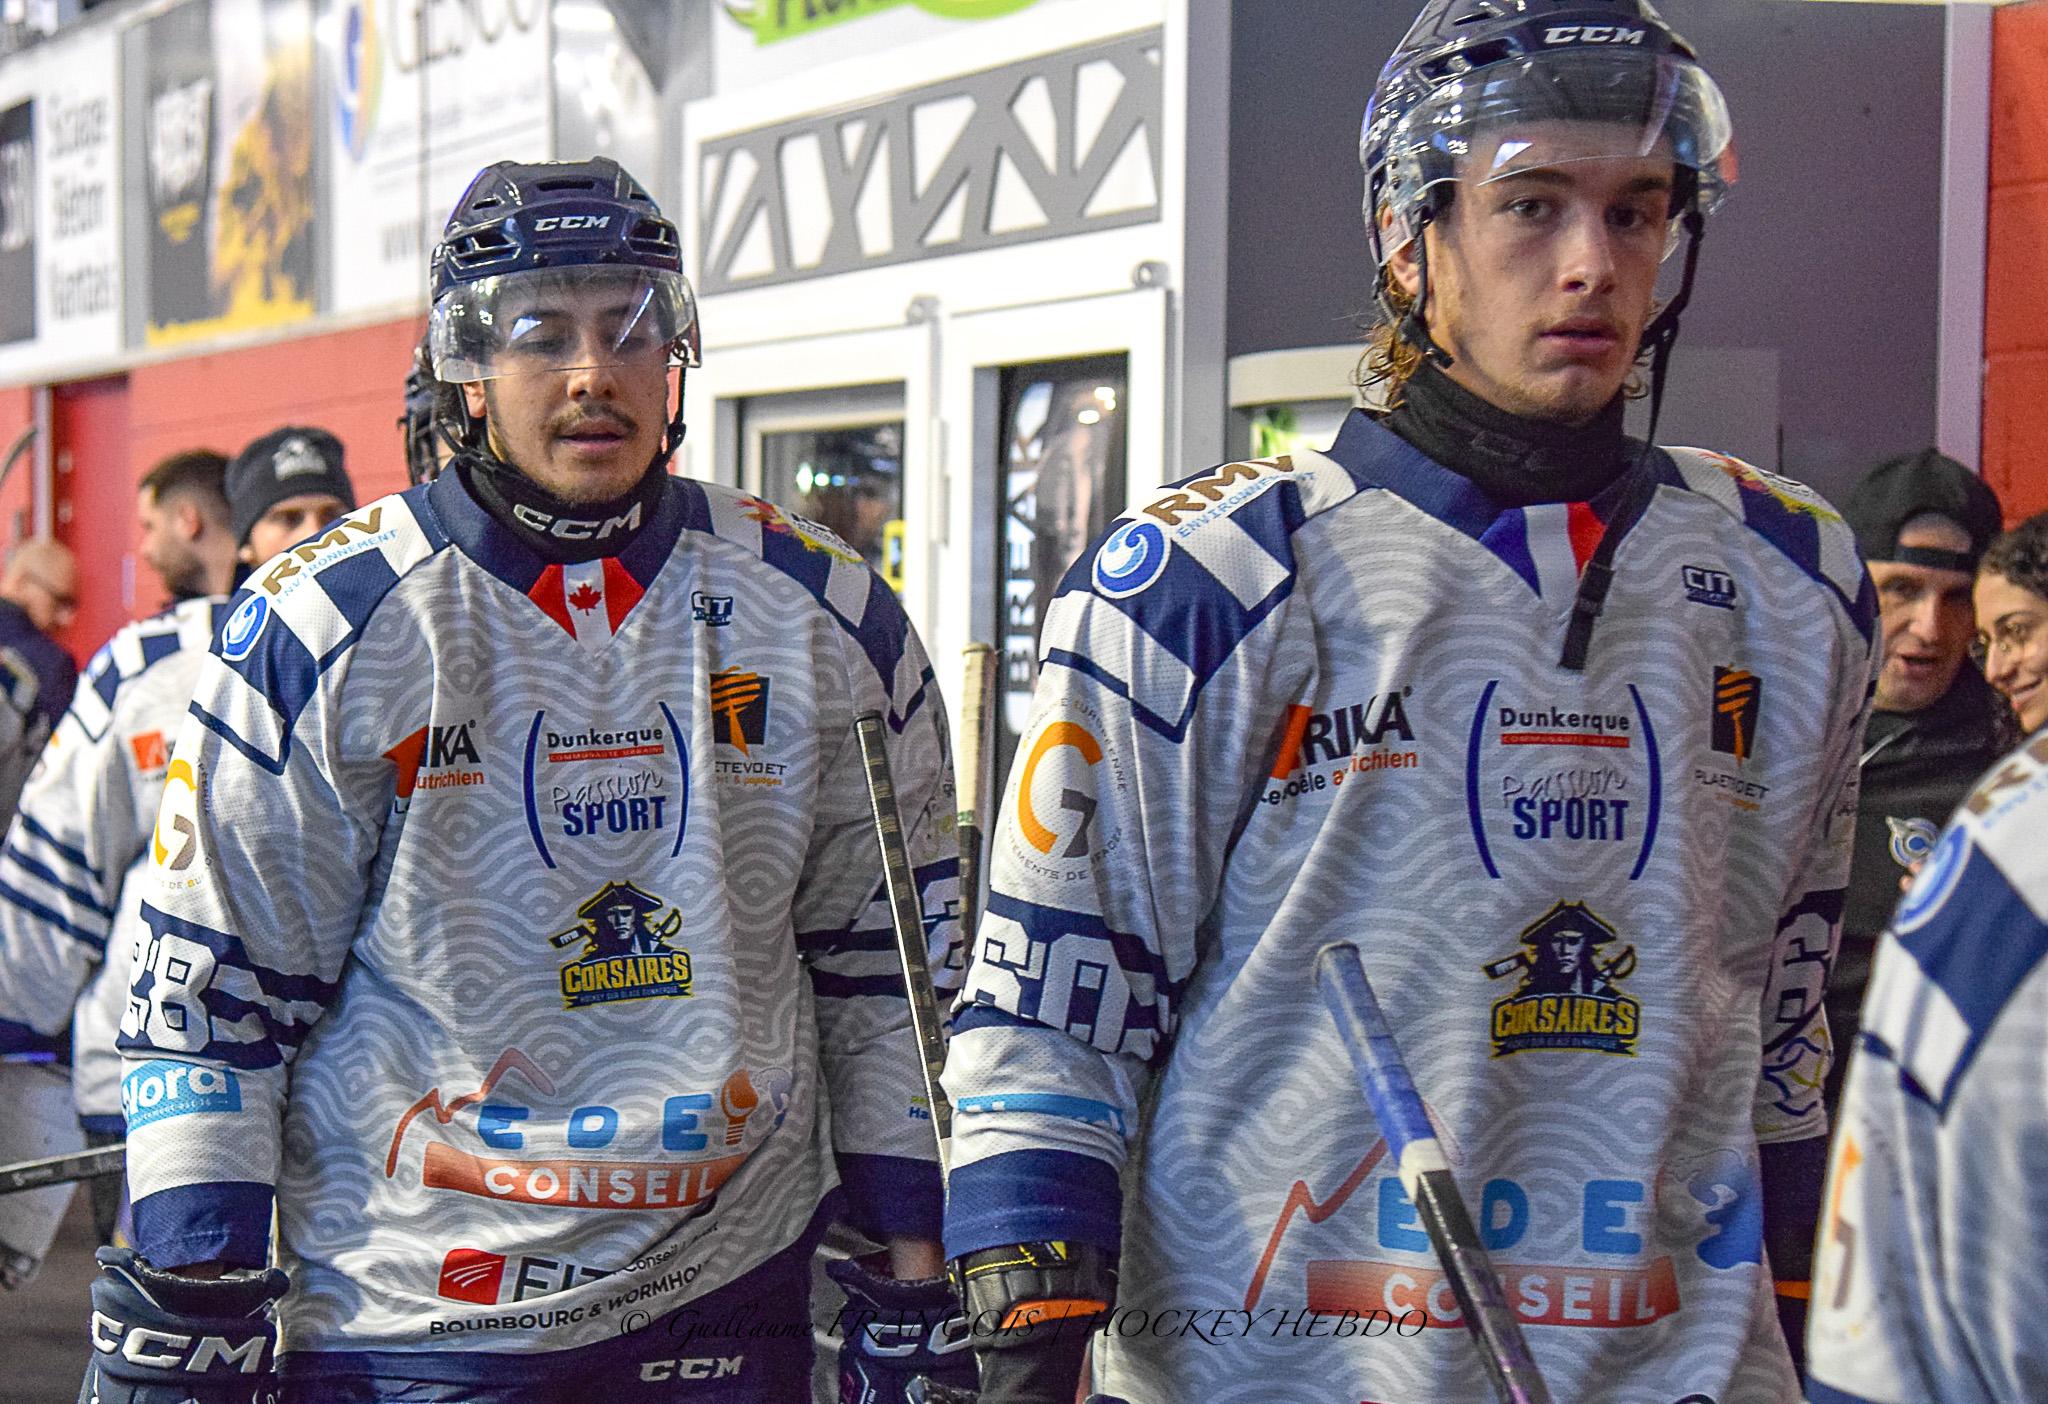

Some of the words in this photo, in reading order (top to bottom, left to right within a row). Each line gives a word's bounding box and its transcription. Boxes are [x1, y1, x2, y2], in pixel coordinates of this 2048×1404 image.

[1543, 25, 1647, 45] CCM
[534, 215, 611, 232] CCM
[1142, 454, 1295, 526] RMV
[513, 501, 642, 540] CCM
[261, 506, 382, 596] RMV
[546, 727, 664, 749] Dunkerque
[1500, 706, 1630, 735] Dunkerque
[562, 795, 667, 838] SPORT
[1512, 796, 1630, 842] SPORT
[564, 953, 690, 994] CORSAIRES
[1495, 997, 1636, 1038] CORSAIRES
[484, 1165, 714, 1204] CONSEIL
[1376, 1176, 1646, 1256] EDE
[1382, 1272, 1656, 1322] COSEIL
[430, 1307, 584, 1336] BOURBOURG
[589, 1302, 602, 1318] &
[91, 1310, 268, 1374] CCM
[639, 1354, 745, 1384] CCM
